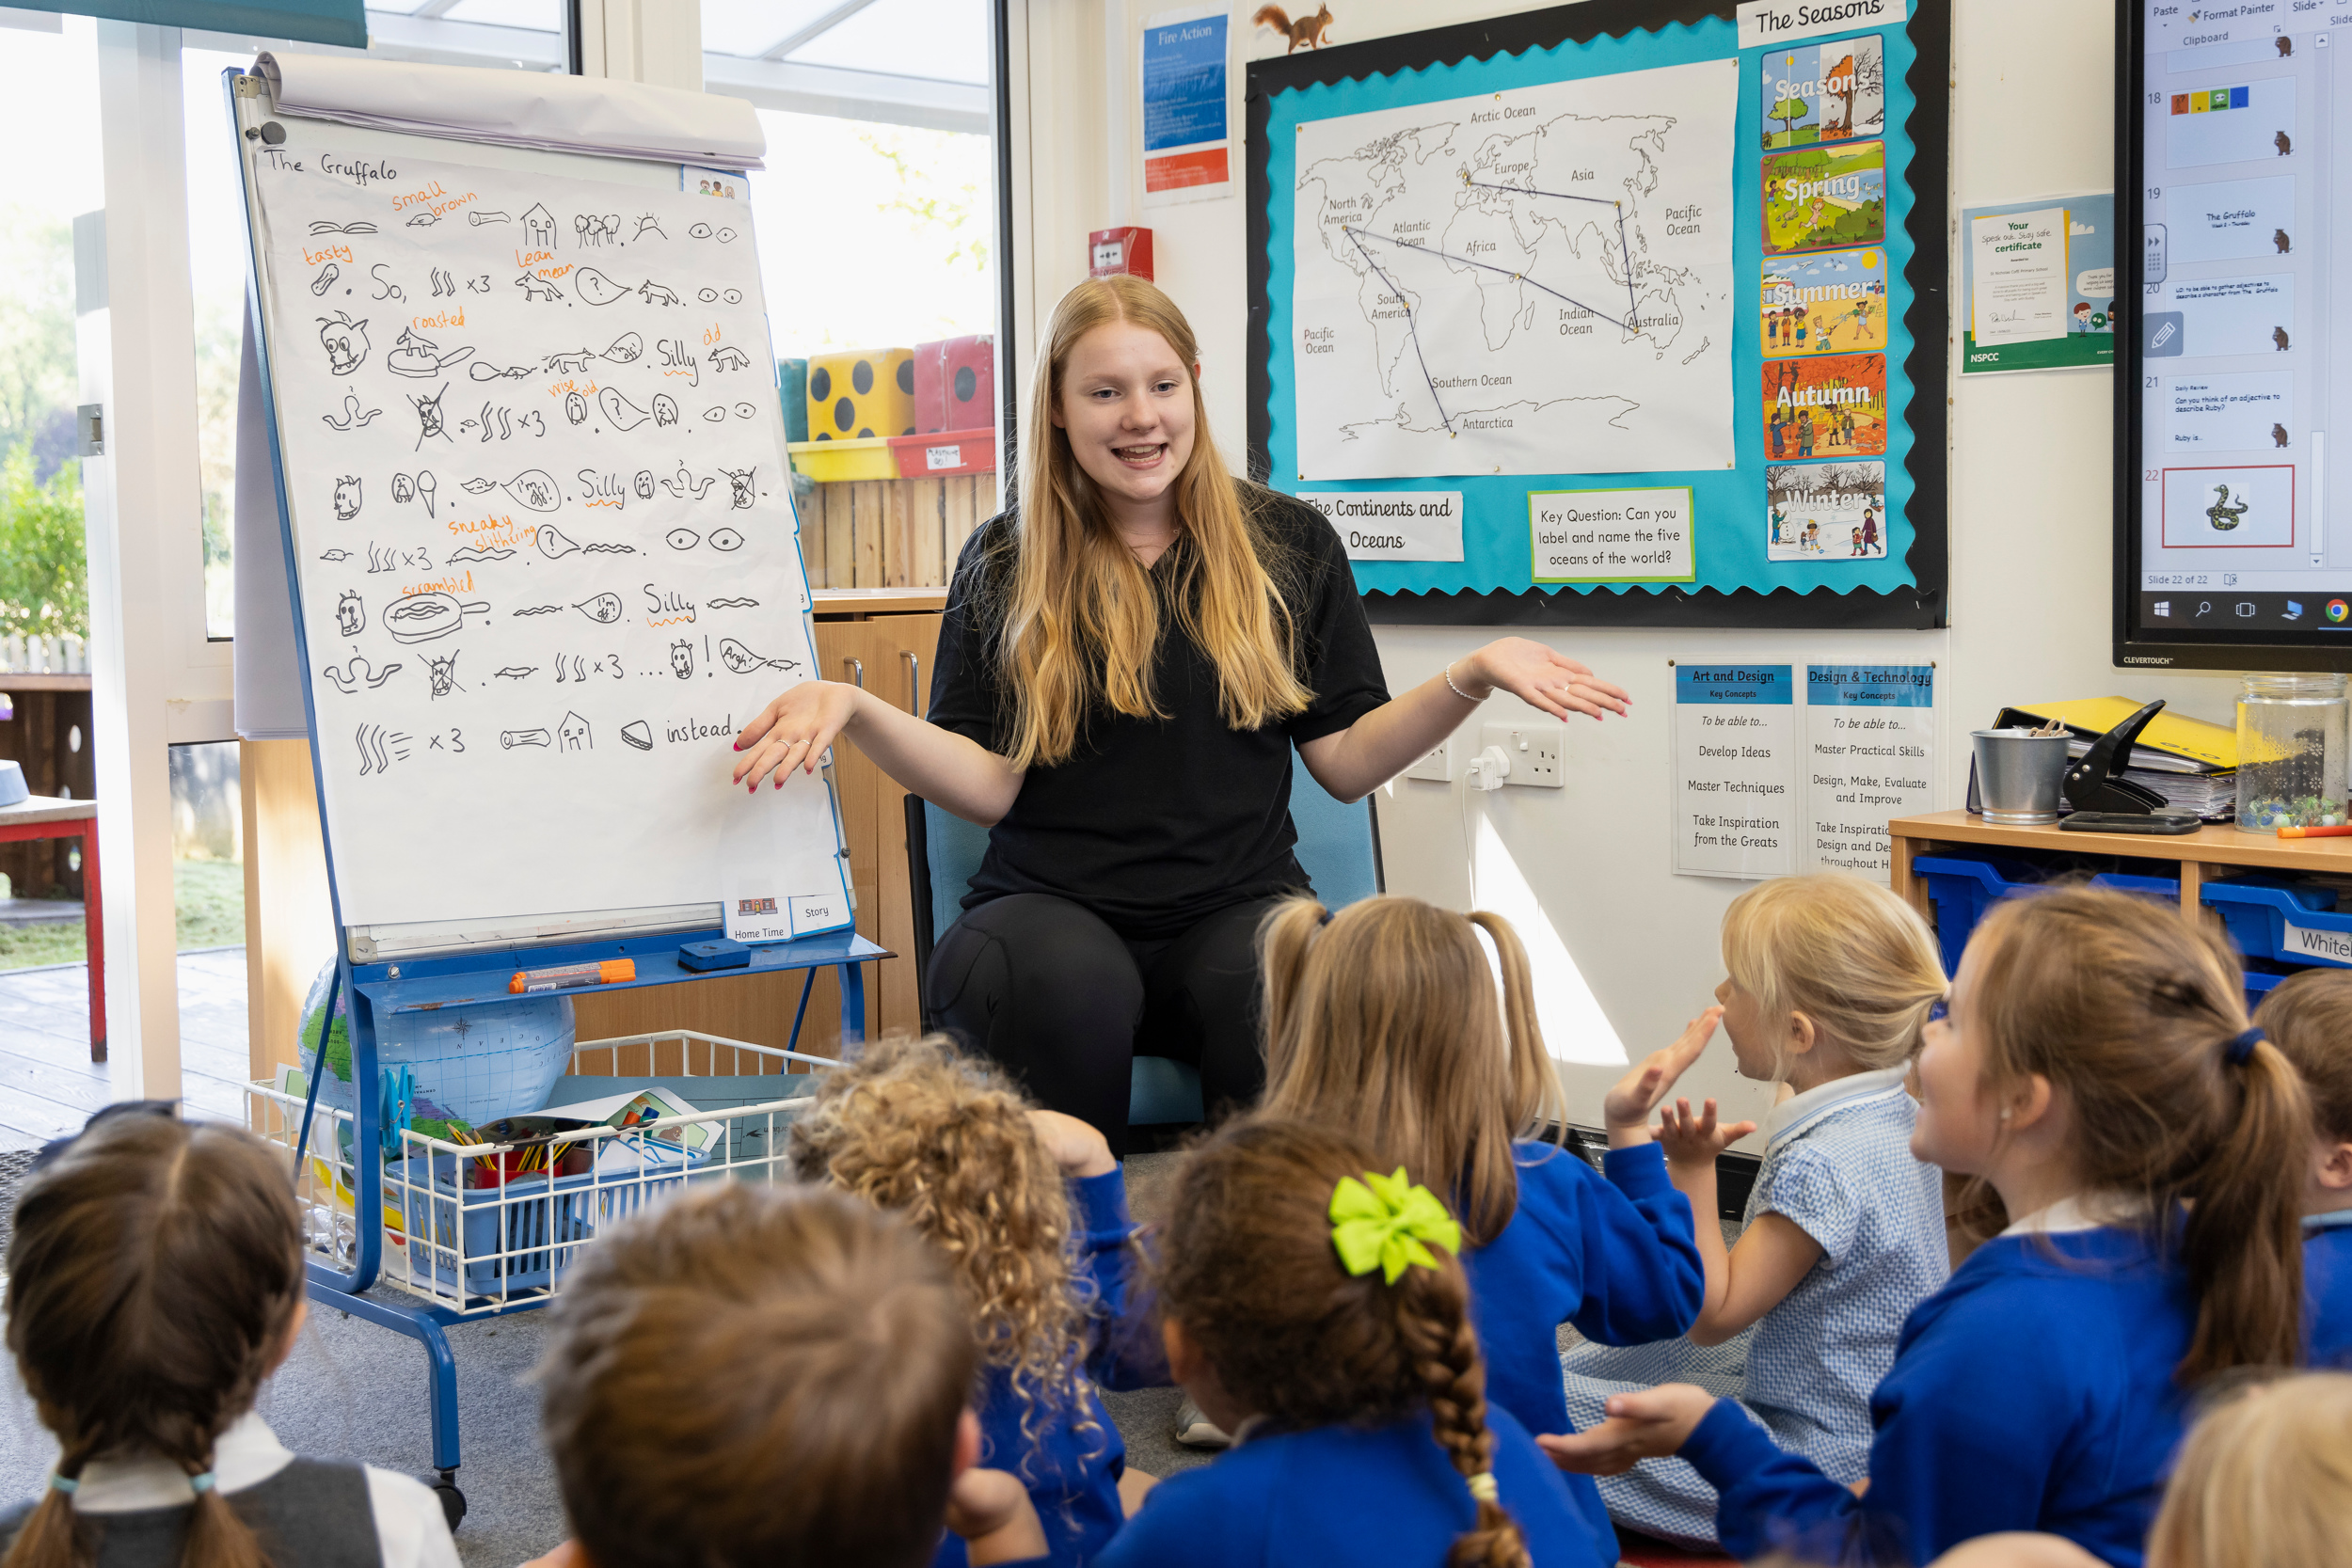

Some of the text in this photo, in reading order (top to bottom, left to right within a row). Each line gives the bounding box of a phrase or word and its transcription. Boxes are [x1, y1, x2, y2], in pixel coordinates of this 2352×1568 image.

[2153, 3, 2275, 21] Paste Format Painter
[2293, 0, 2316, 11] Slide
[1756, 0, 1885, 32] The Seasons
[2330, 15, 2352, 25] Slide
[1158, 24, 1212, 45] Fire Action
[2183, 32, 2229, 46] Clipboard
[1774, 71, 1870, 102] Seasons
[2147, 92, 2161, 104] 18
[1470, 105, 1536, 123] Arctic Ocean
[263, 150, 397, 186] The Gruffalo
[1494, 161, 1530, 175] Europe
[1571, 169, 1595, 182] Asia
[392, 181, 447, 212] small
[1784, 173, 1861, 206] Spring
[2147, 188, 2161, 199] 19
[427, 191, 478, 217] brown
[1329, 197, 1357, 210] North
[1324, 212, 1362, 225] America
[1665, 205, 1702, 220] Pacific
[2223, 210, 2255, 219] Gruffalo
[1392, 219, 1431, 233] Atlantic
[1666, 222, 1701, 235] Ocean
[2008, 222, 2028, 230] Your
[1396, 237, 1425, 247] Ocean
[1982, 234, 2001, 245] Speak
[2018, 231, 2034, 241] Stay
[1466, 240, 1497, 254] Africa
[1995, 242, 2042, 252] certificate
[302, 245, 354, 265] tasty
[538, 263, 575, 280] mean
[371, 263, 407, 304] So,
[2146, 283, 2160, 294] 20
[1377, 293, 1406, 305] South
[1772, 278, 1873, 307] Summer
[413, 308, 466, 328] roasted
[1372, 309, 1410, 320] America
[1560, 308, 1595, 320] Indian
[1629, 313, 1679, 327] Australia
[703, 323, 722, 345] old
[1304, 327, 1334, 341] Pacific
[1560, 325, 1593, 335] Ocean
[1306, 341, 1334, 354] Ocean
[657, 340, 699, 388] Silly
[1971, 353, 1999, 363] NSPCC
[1432, 374, 1512, 388] Southern Ocean
[2146, 376, 2158, 388] 21
[548, 379, 598, 398] wise old
[1776, 386, 1871, 408] Autumn
[2239, 394, 2271, 403] adjective
[1463, 417, 1514, 430] Antarctica
[2145, 470, 2158, 482] 22
[578, 468, 626, 510] Silly
[1336, 499, 1416, 516] Continents
[1420, 498, 1453, 516] and
[1786, 489, 1865, 513] Winter
[1541, 507, 1677, 525] Key Question: Can you
[448, 514, 513, 536] sneaky
[475, 525, 537, 552] slithering
[1350, 531, 1406, 548] Oceans
[1539, 529, 1680, 544] label and name the five
[1550, 550, 1671, 565] oceans of the world?
[402, 570, 476, 600] scrambled
[644, 583, 696, 624] Silly
[1692, 670, 1774, 684] Art and Design
[1809, 671, 1931, 687] Design & Technology
[1710, 690, 1756, 699] Key Concepts
[1844, 691, 1896, 701] Key Concepts
[1702, 716, 1768, 726] To be able to...
[1834, 718, 1906, 730] To be able to...
[1699, 745, 1771, 760] Develop Ideas
[1815, 744, 1925, 757] Master Practical Skills
[1688, 780, 1785, 796] Master Techniques
[1813, 774, 1927, 788] Design, Make, Evaluate
[1836, 793, 1902, 806] and Improve
[1692, 815, 1780, 831] Take Inspiration
[1816, 822, 1889, 836] Take Inspiratio
[1694, 832, 1778, 847] from the Greats
[1817, 839, 1871, 852] Design and
[1821, 855, 1877, 869] throughout
[805, 906, 830, 918] Story
[735, 928, 784, 939] Home Time
[2301, 931, 2352, 958] White
